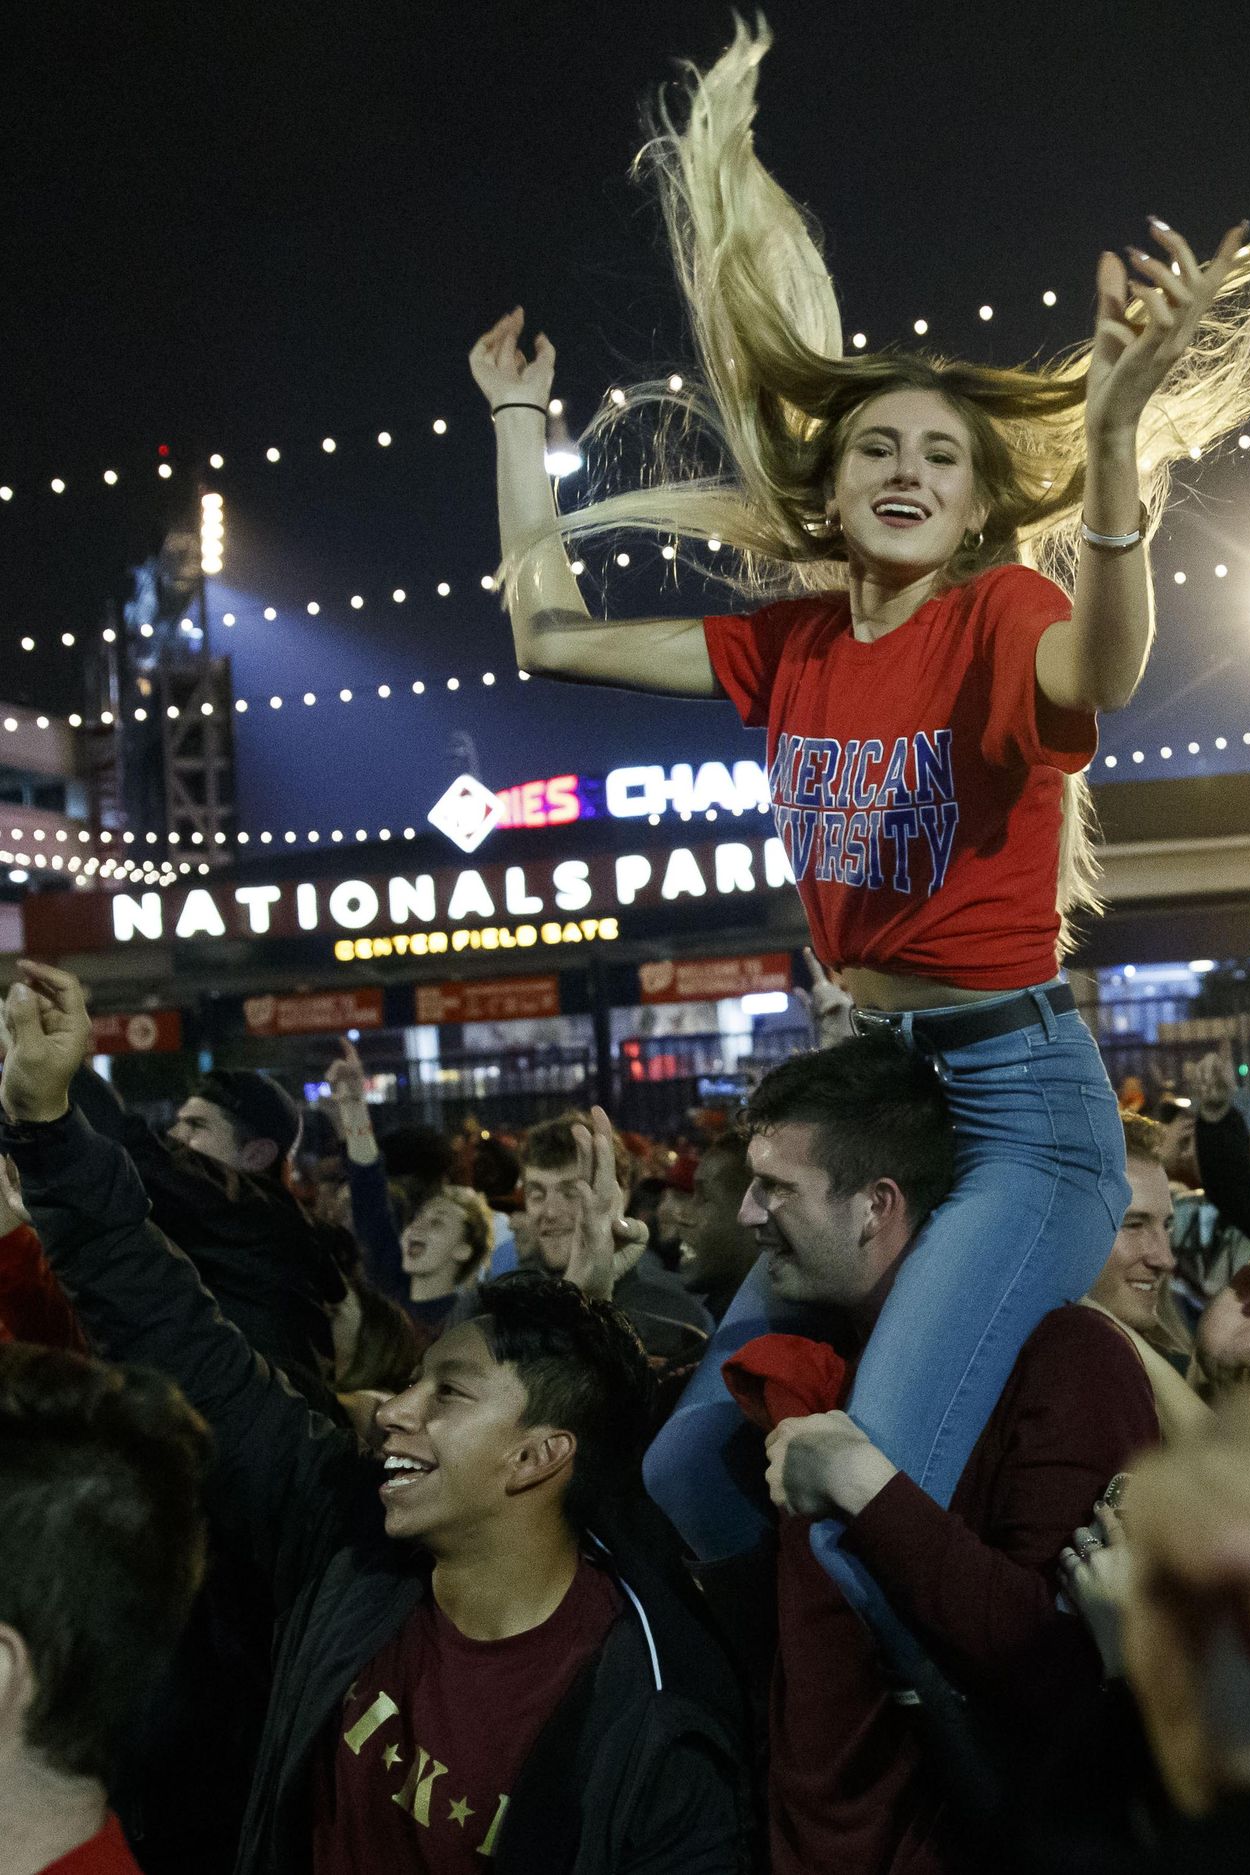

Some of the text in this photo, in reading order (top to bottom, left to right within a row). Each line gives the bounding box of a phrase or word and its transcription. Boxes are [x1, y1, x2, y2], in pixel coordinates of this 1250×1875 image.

[113, 860, 592, 941] NATIONALS
[334, 917, 619, 961] CENTER FIELD GATE
